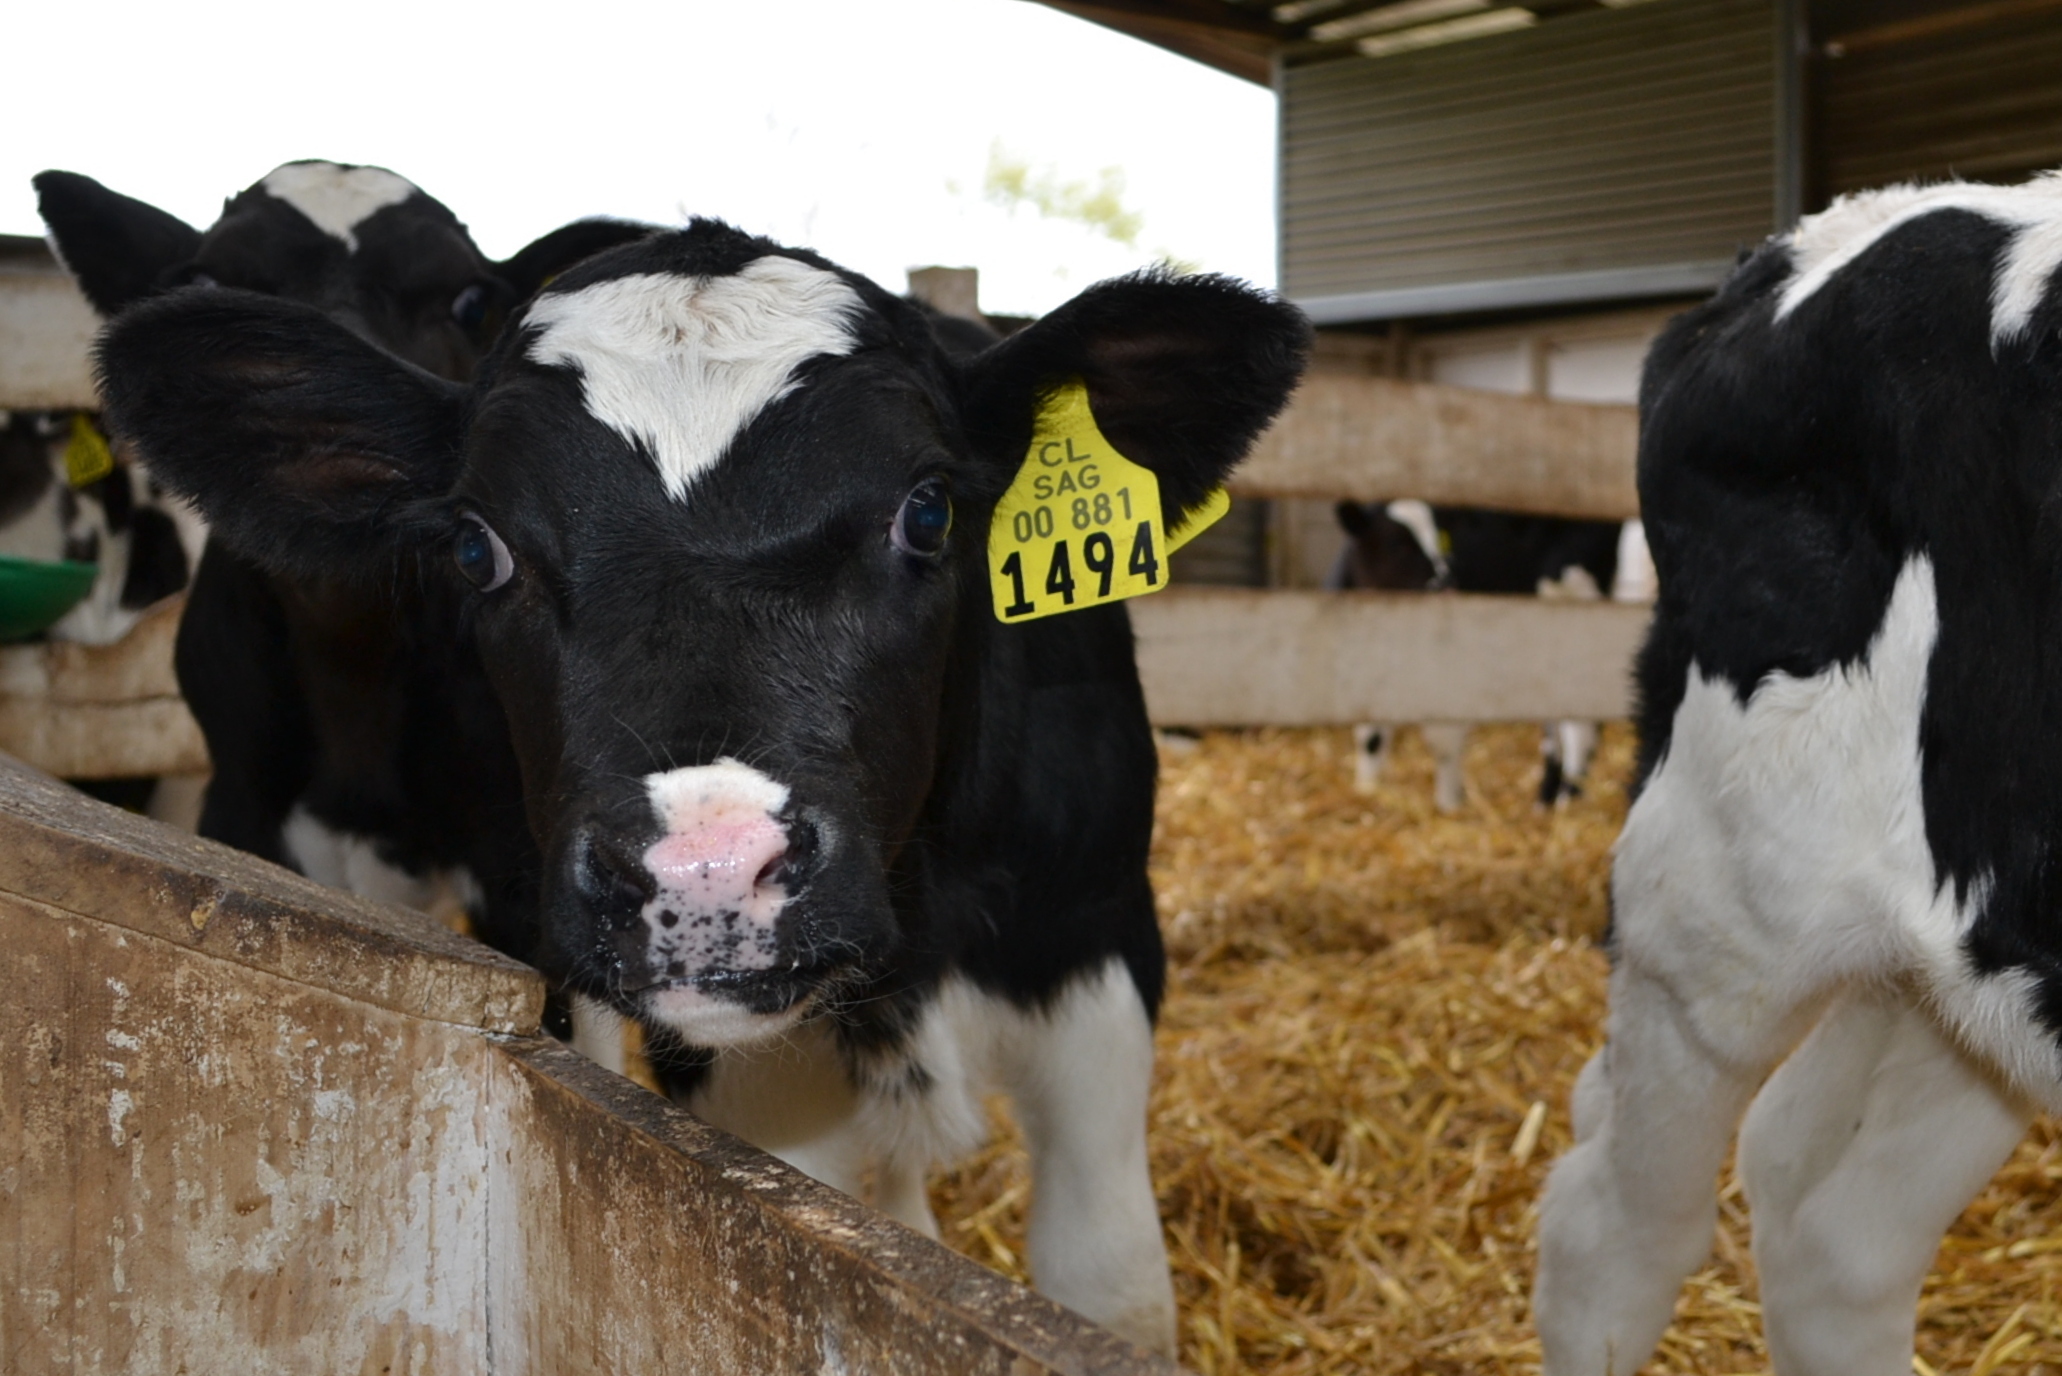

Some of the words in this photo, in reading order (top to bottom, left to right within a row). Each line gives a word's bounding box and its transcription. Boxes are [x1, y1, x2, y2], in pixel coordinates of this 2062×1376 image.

[1039, 437, 1091, 467] CL
[1033, 464, 1101, 500] SAG
[1013, 505, 1054, 543] 00
[1071, 487, 1132, 530] 881
[1000, 520, 1159, 618] 1494
